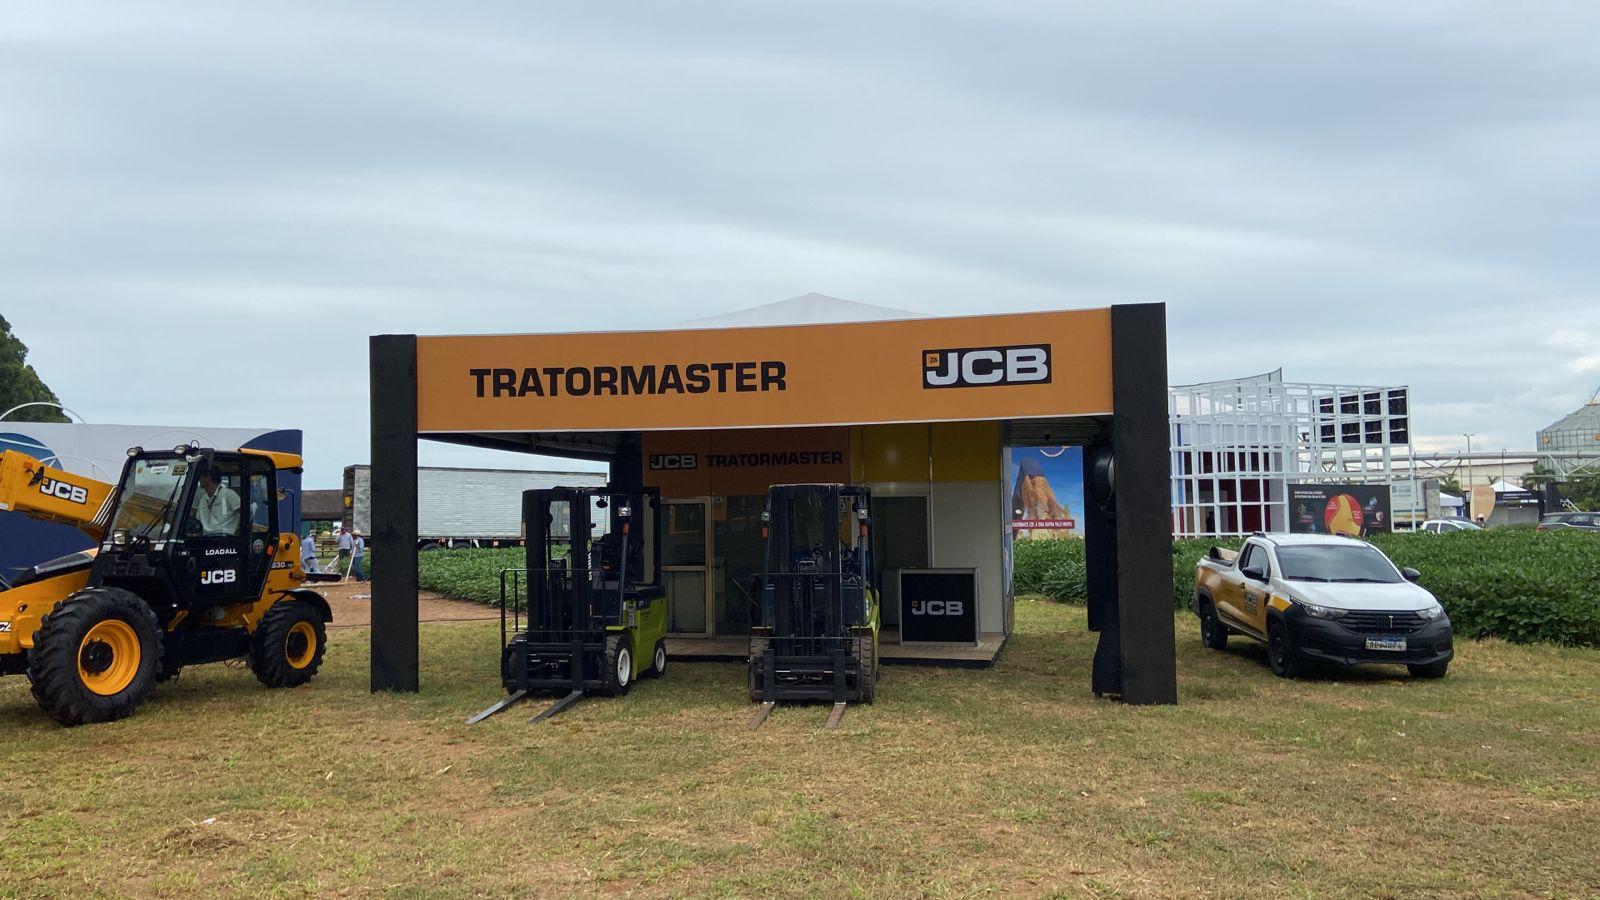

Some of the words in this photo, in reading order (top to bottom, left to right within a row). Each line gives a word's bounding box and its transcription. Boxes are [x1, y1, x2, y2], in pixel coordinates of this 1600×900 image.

[926, 347, 1049, 386] JCB
[469, 361, 787, 398] TRATORMASTER
[650, 454, 697, 470] JCB
[705, 451, 843, 468] TRATORMASTER
[40, 479, 87, 503] JCB
[205, 548, 238, 556] LOADALL
[201, 569, 237, 585] JCB
[911, 600, 964, 616] JCB
